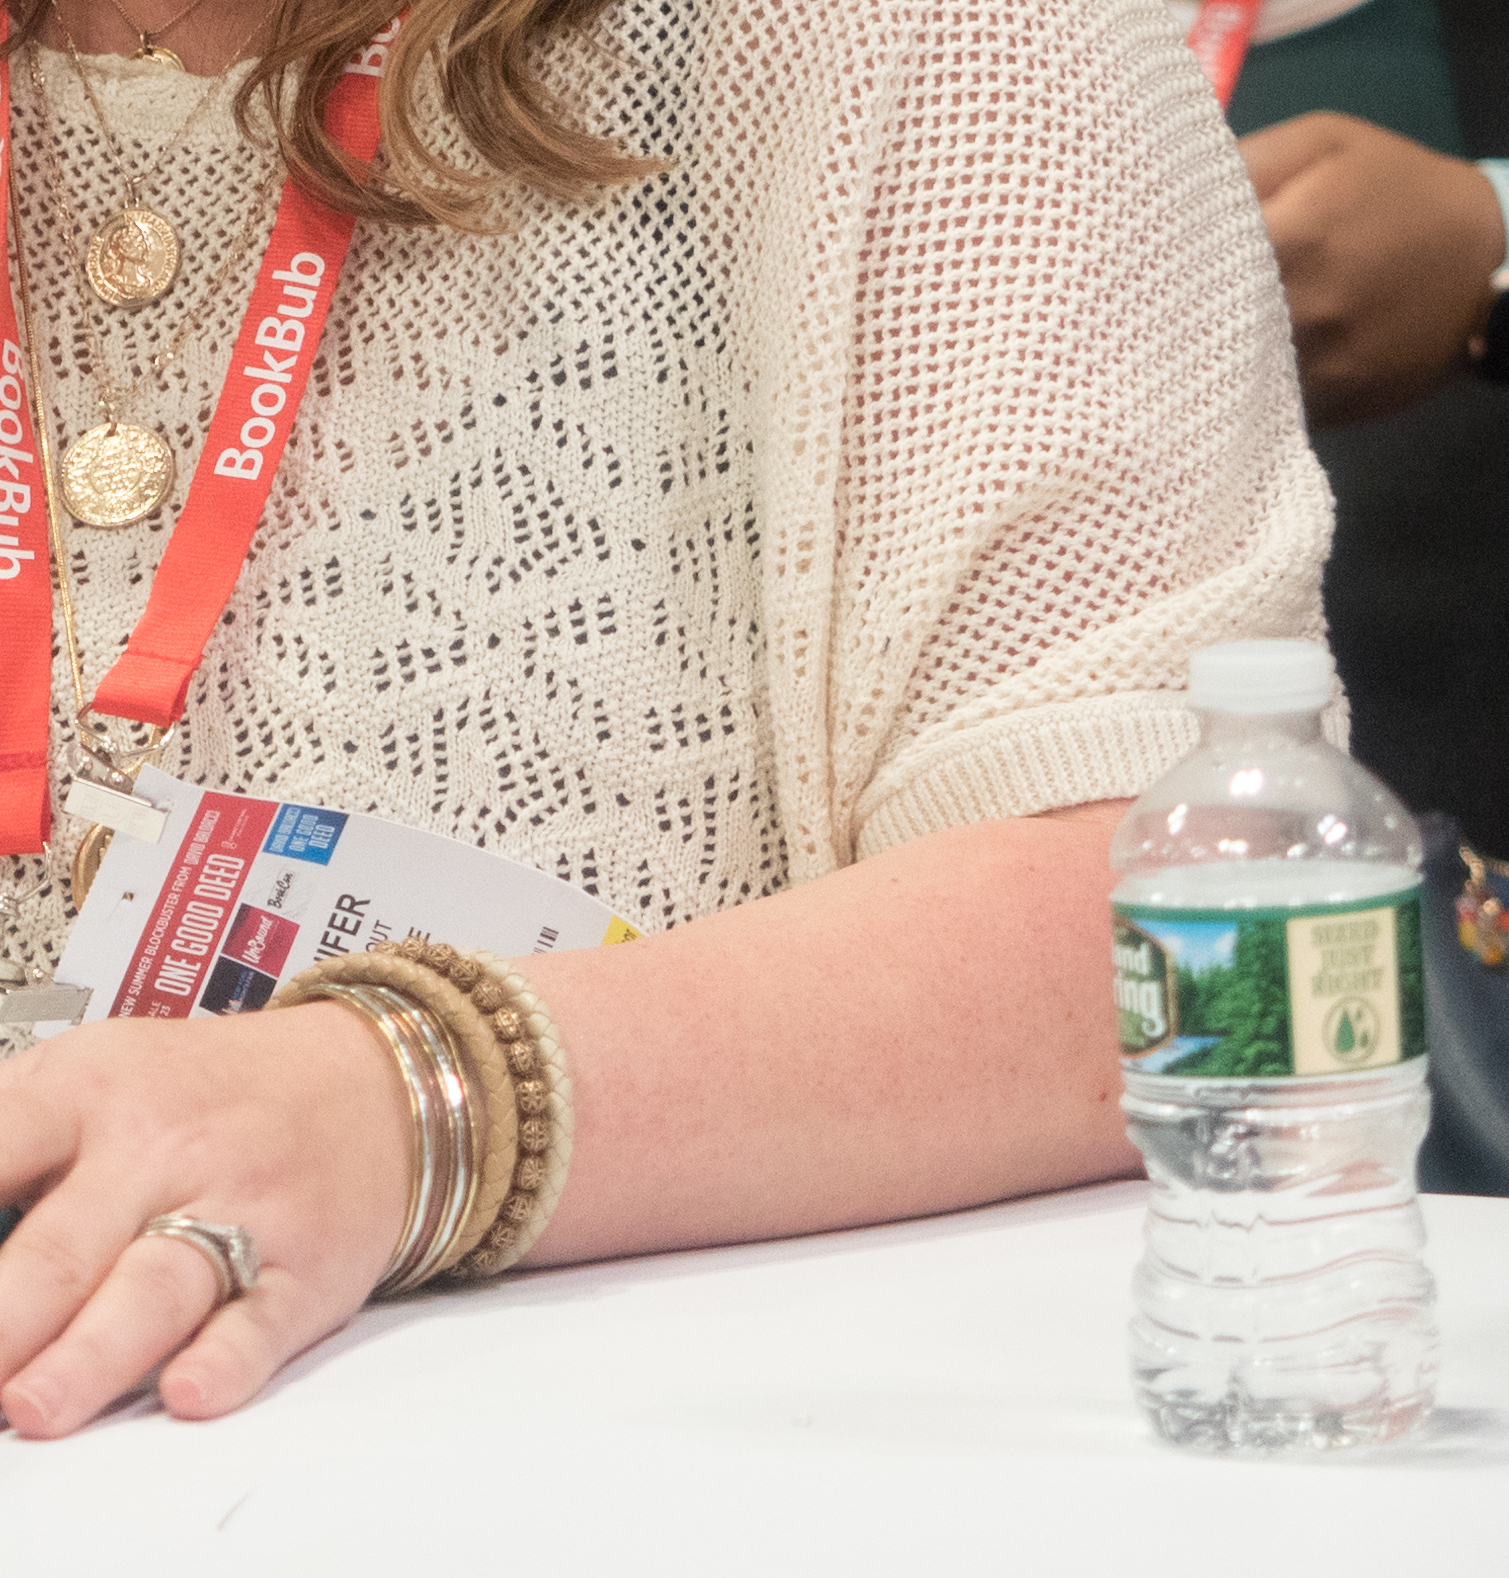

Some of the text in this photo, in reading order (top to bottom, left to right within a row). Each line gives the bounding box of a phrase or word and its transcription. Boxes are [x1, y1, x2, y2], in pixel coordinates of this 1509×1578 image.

[213, 252, 326, 480] BookBub
[308, 824, 336, 850] DEED
[193, 853, 245, 901] DEED
[267, 872, 294, 909] BookCon
[118, 995, 137, 1019] NEW
[128, 955, 154, 996] SUMMER
[144, 892, 182, 956] BLOCKBUSTER
[171, 865, 192, 893] FROM
[171, 900, 224, 956] GOOD
[313, 894, 371, 961] IFER
[153, 955, 202, 997] ONE
[147, 1000, 162, 1018] ALE
